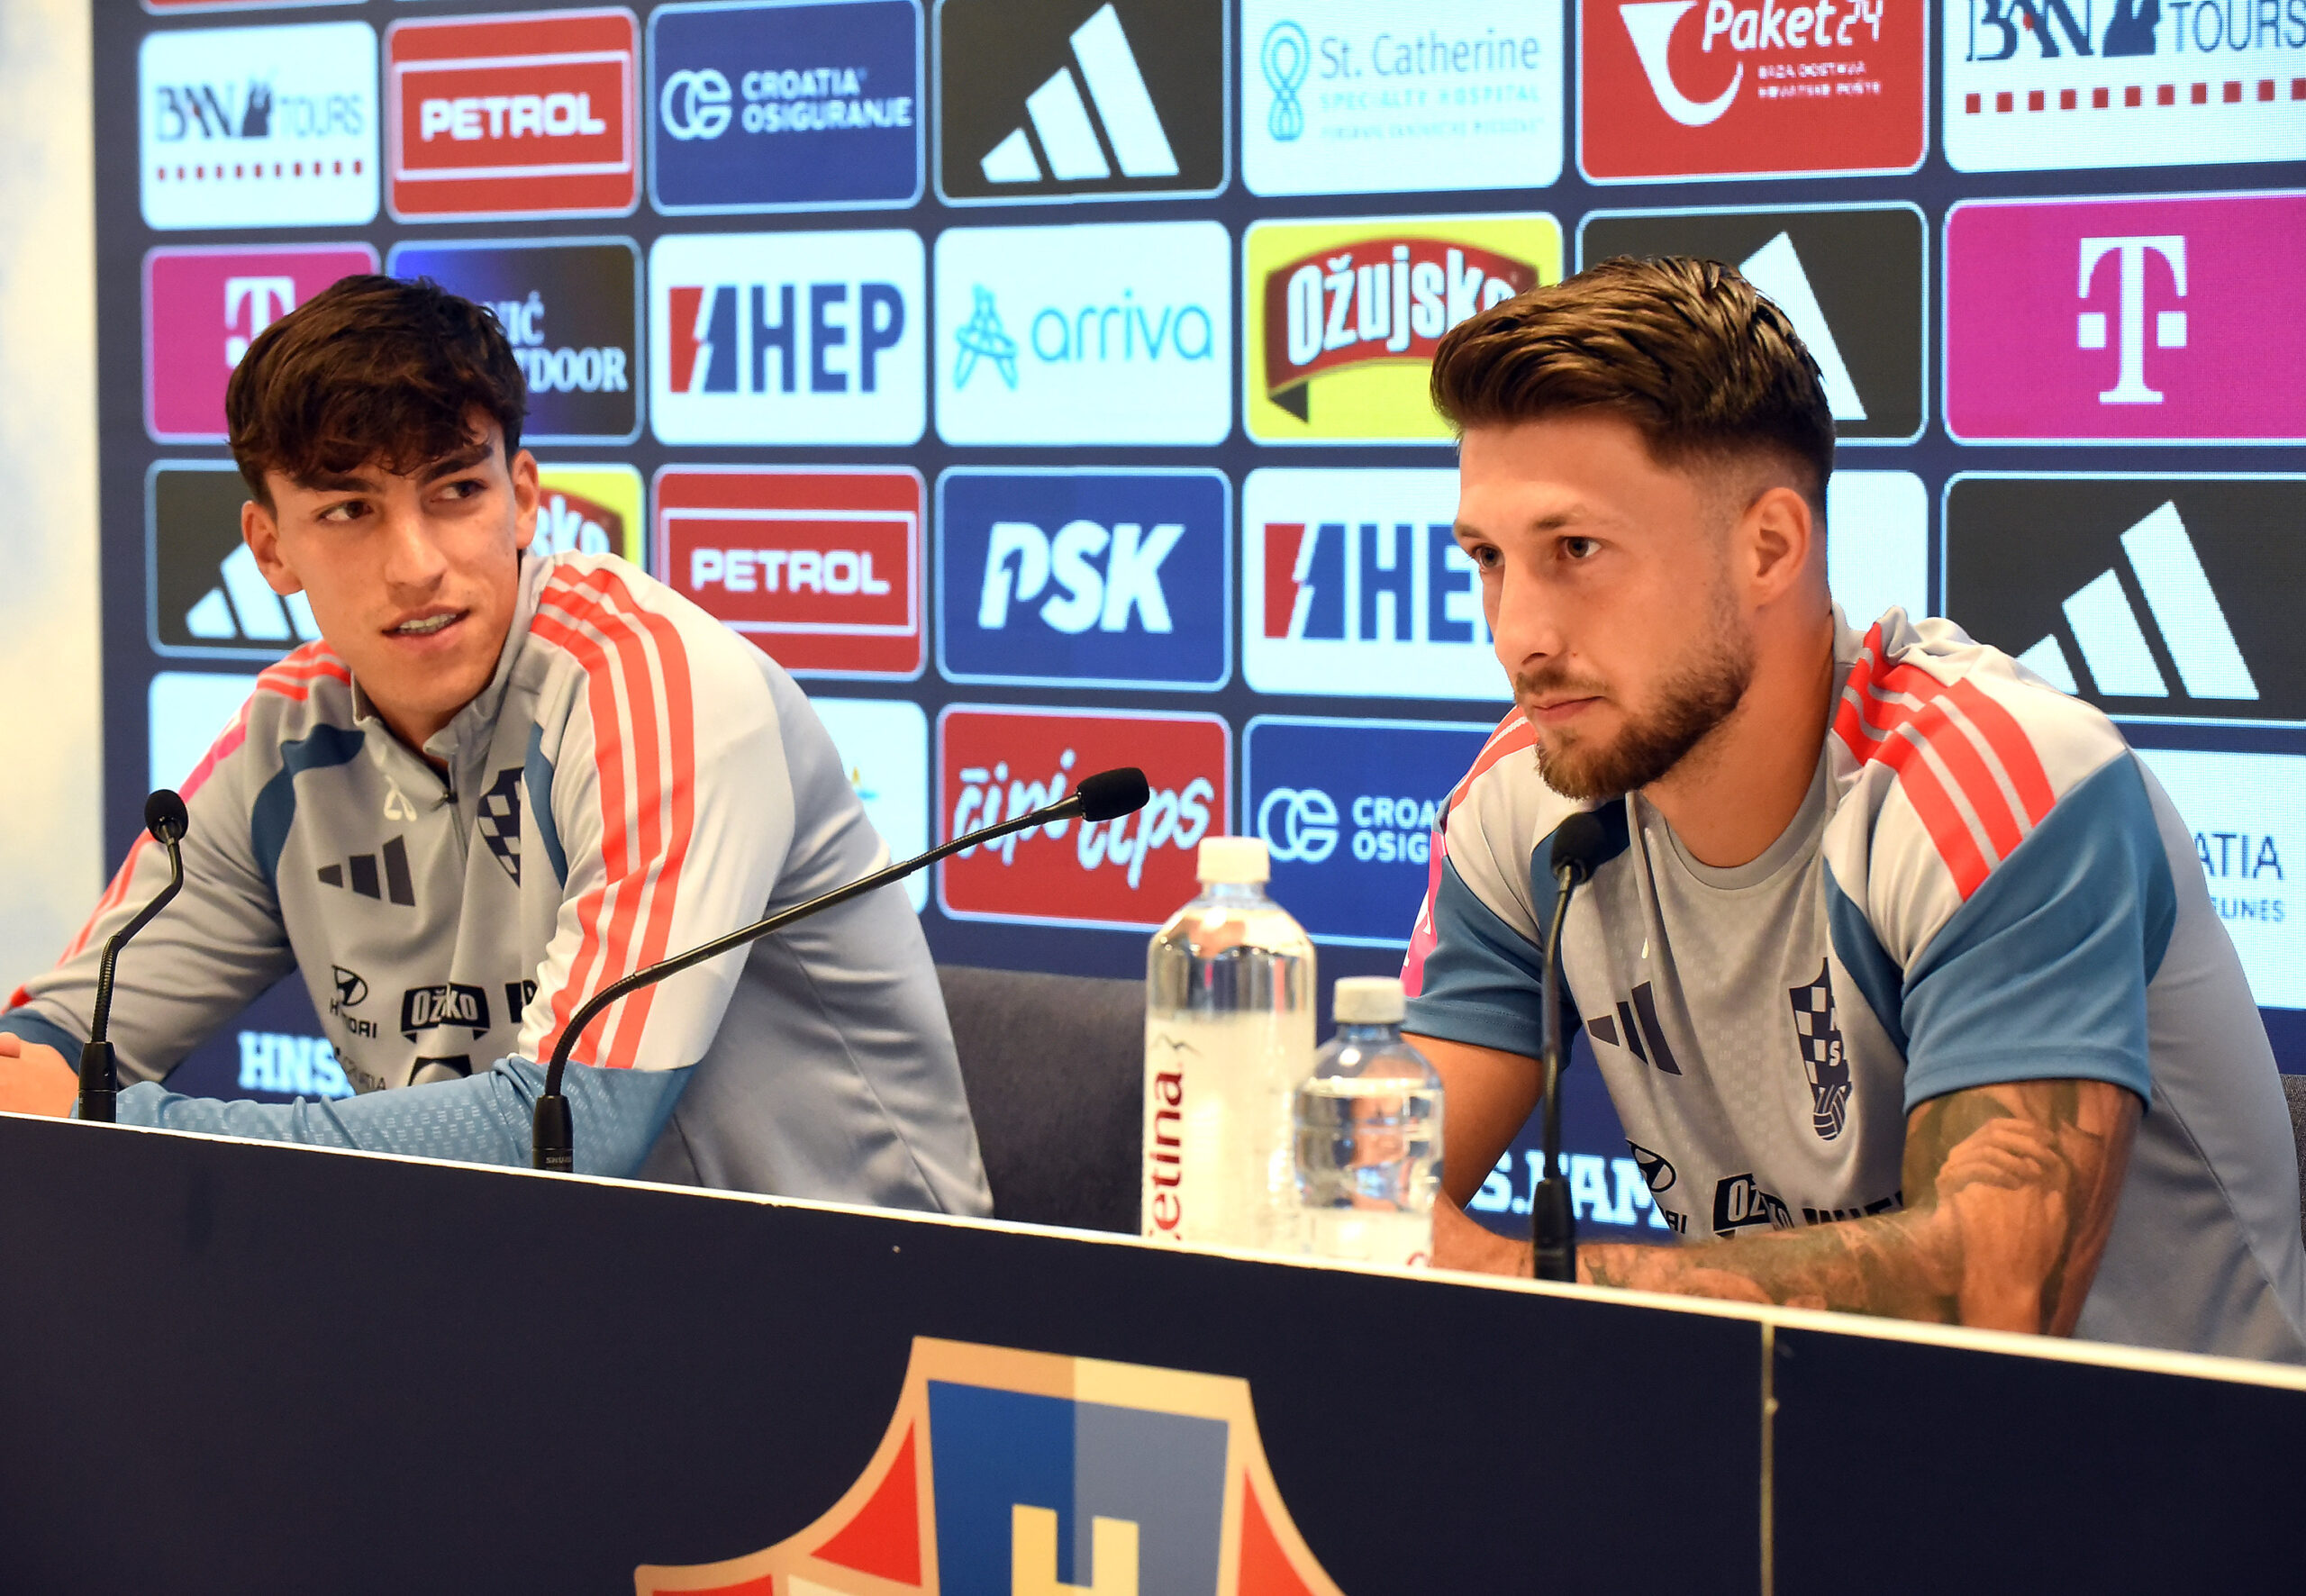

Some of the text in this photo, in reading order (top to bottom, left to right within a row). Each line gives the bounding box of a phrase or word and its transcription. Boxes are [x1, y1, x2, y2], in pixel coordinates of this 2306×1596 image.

[1320, 28, 1539, 79] St. Catherine
[741, 68, 861, 101] CROATIA
[421, 93, 606, 141] PETROL
[741, 96, 912, 133] OSIGURANJE
[750, 283, 908, 394] HEP
[1030, 288, 1214, 361] arriva
[691, 549, 890, 595] PETROL
[978, 520, 1186, 635] PSK
[1358, 522, 1493, 644] HE
[1352, 795, 1441, 830] CROA
[1352, 830, 1431, 866] OSIG
[2194, 831, 2283, 880] ATIA
[1148, 1071, 1183, 1241] etina
